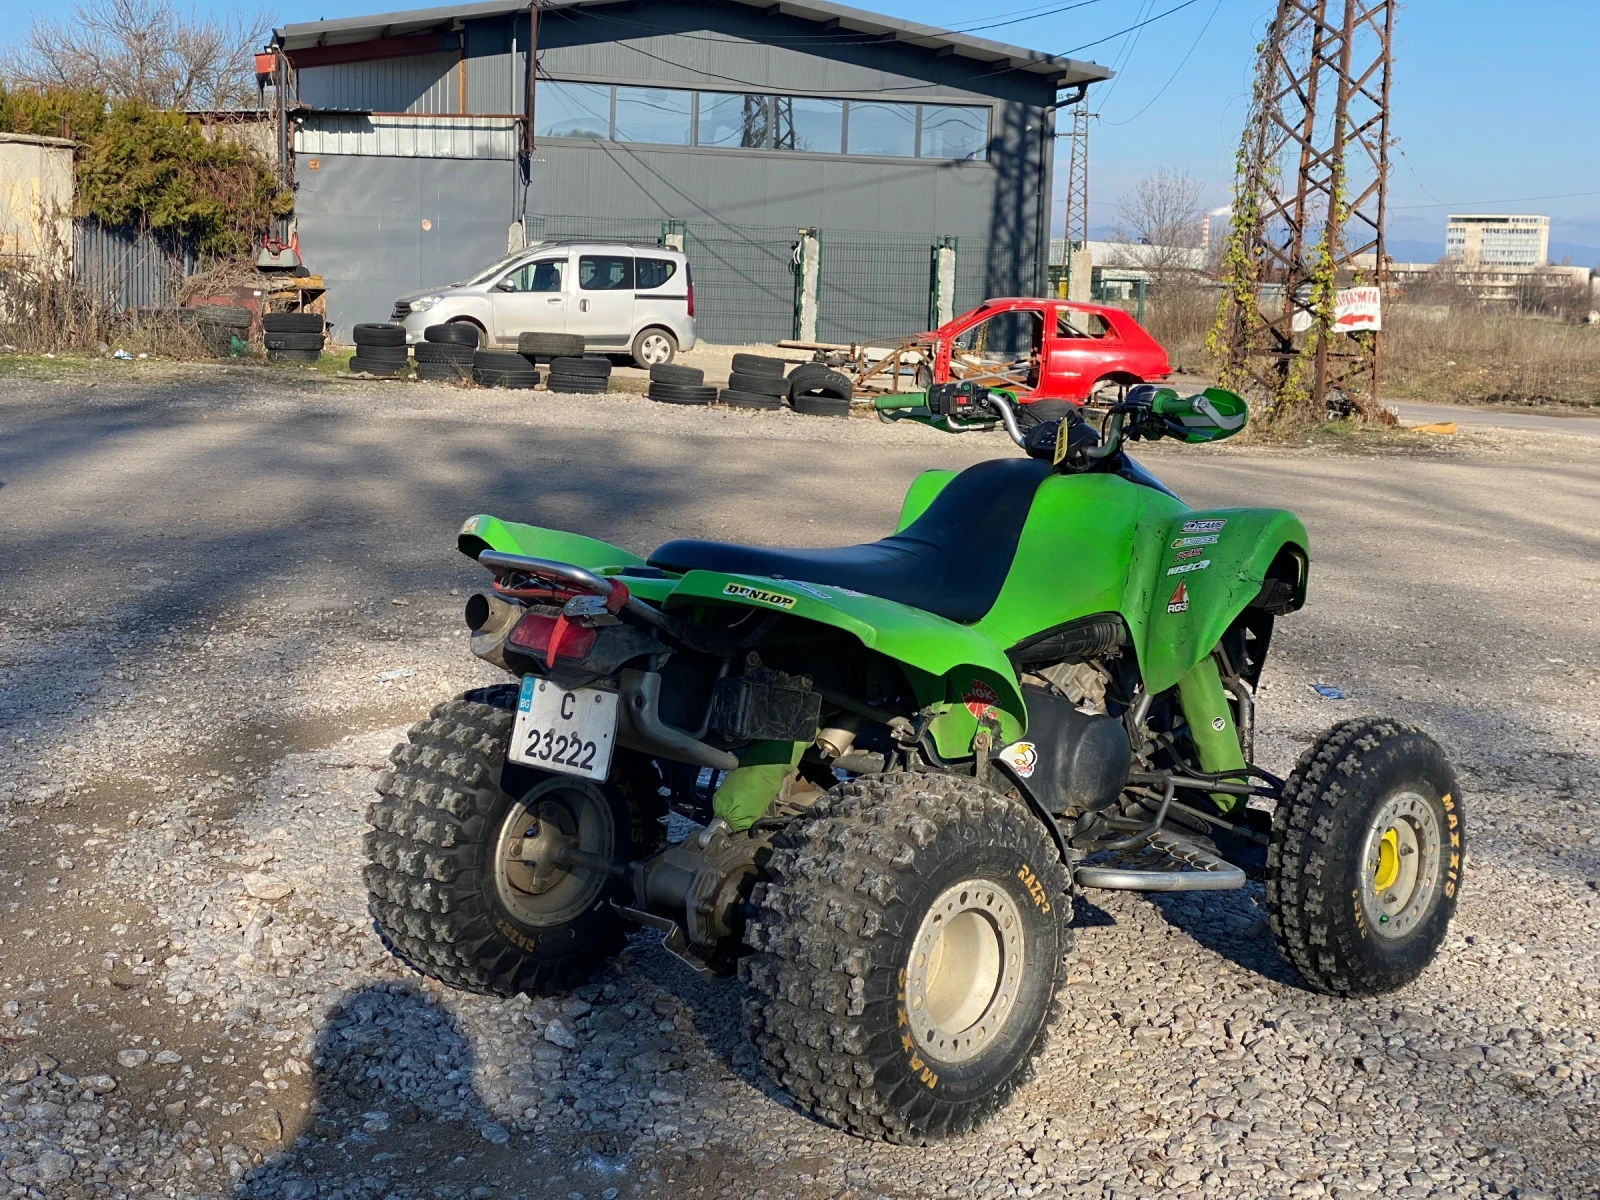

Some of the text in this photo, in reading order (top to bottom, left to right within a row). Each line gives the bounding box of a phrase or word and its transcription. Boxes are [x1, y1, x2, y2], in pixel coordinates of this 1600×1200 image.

[727, 584, 794, 606] DUNLOP
[520, 699, 530, 709] BG
[560, 692, 576, 720] C
[525, 729, 597, 771] 23222
[1441, 793, 1460, 899] MAXXIS
